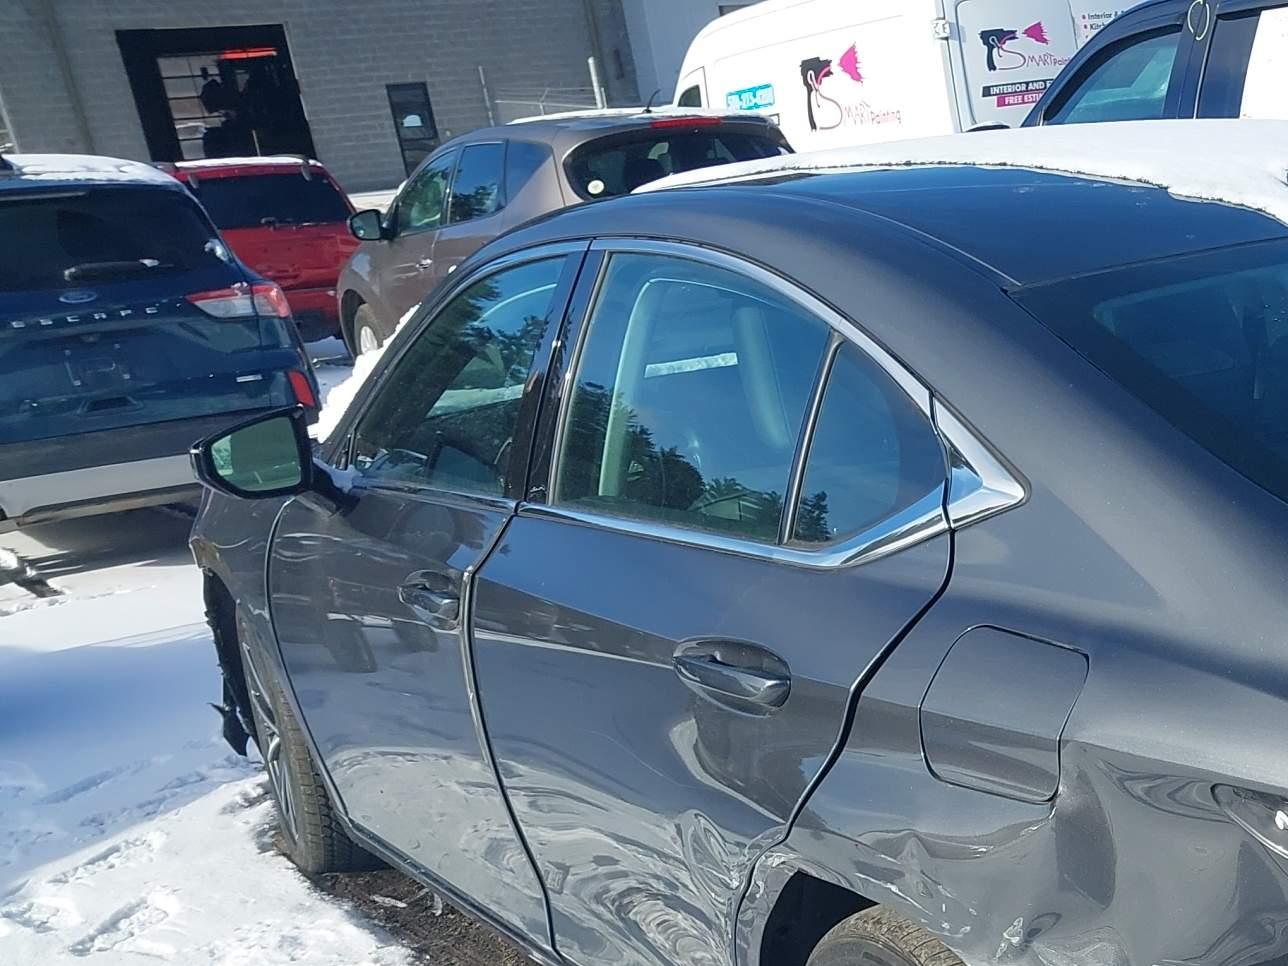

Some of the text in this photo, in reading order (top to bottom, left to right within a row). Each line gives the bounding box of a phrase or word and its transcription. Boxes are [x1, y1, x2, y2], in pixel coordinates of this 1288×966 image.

[990, 84, 1027, 95] INTERIOR
[1028, 81, 1045, 91] AND
[1005, 92, 1041, 105] FREE ESTI
